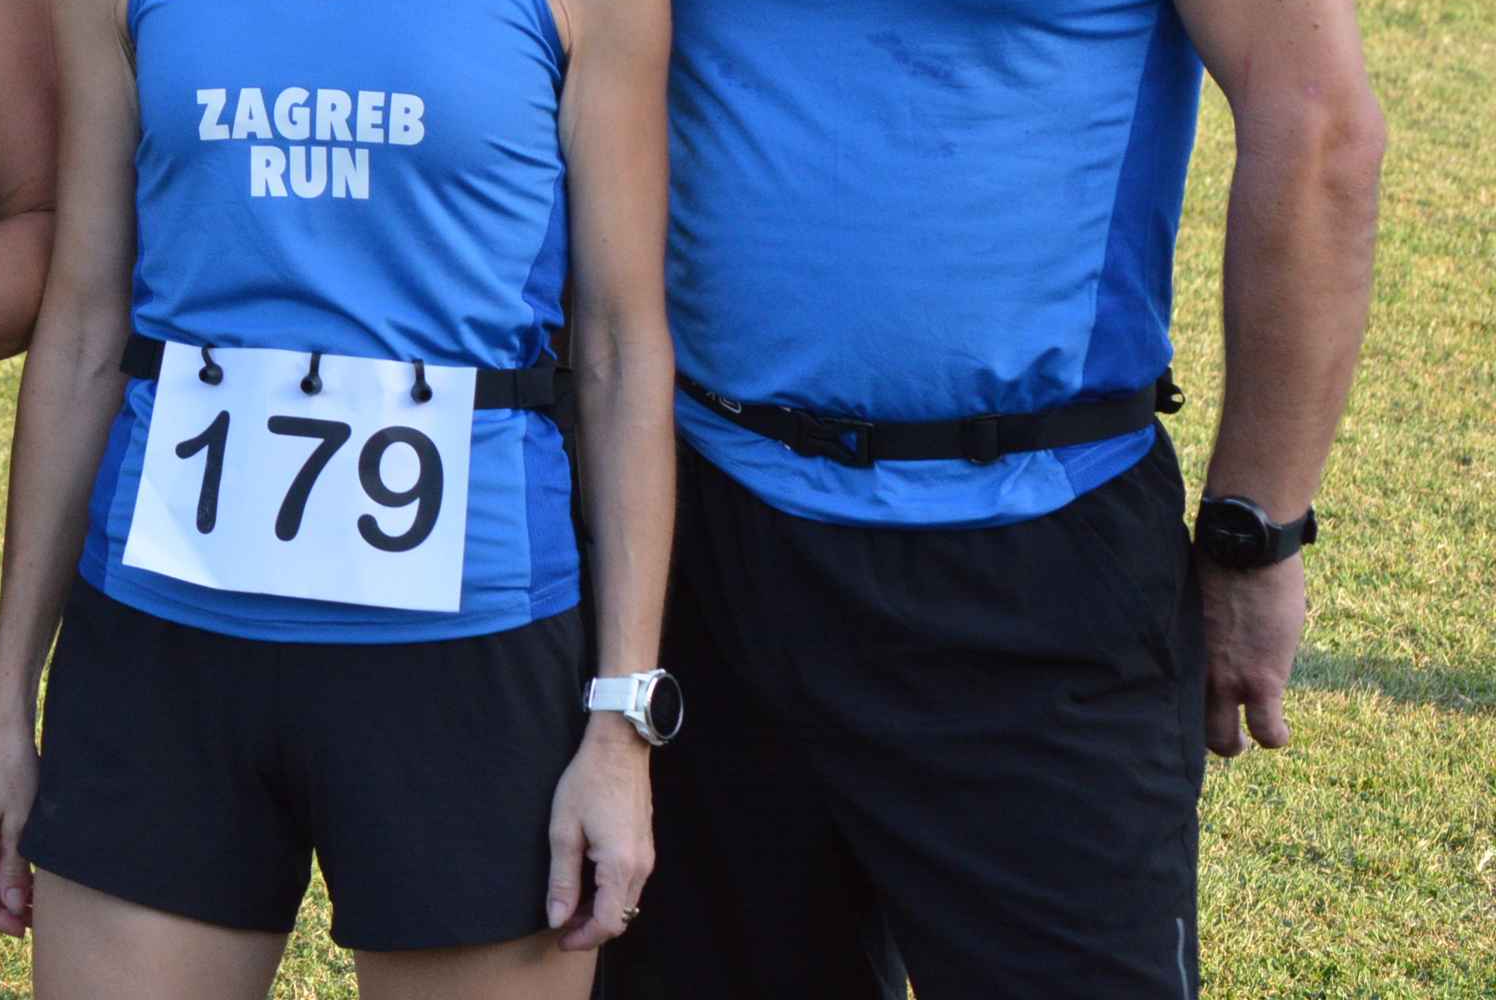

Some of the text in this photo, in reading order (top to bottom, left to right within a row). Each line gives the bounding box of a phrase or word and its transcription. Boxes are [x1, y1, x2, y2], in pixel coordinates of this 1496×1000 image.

[196, 86, 425, 146] ZAGREB
[250, 145, 370, 200] RUN
[175, 410, 444, 553] 179
